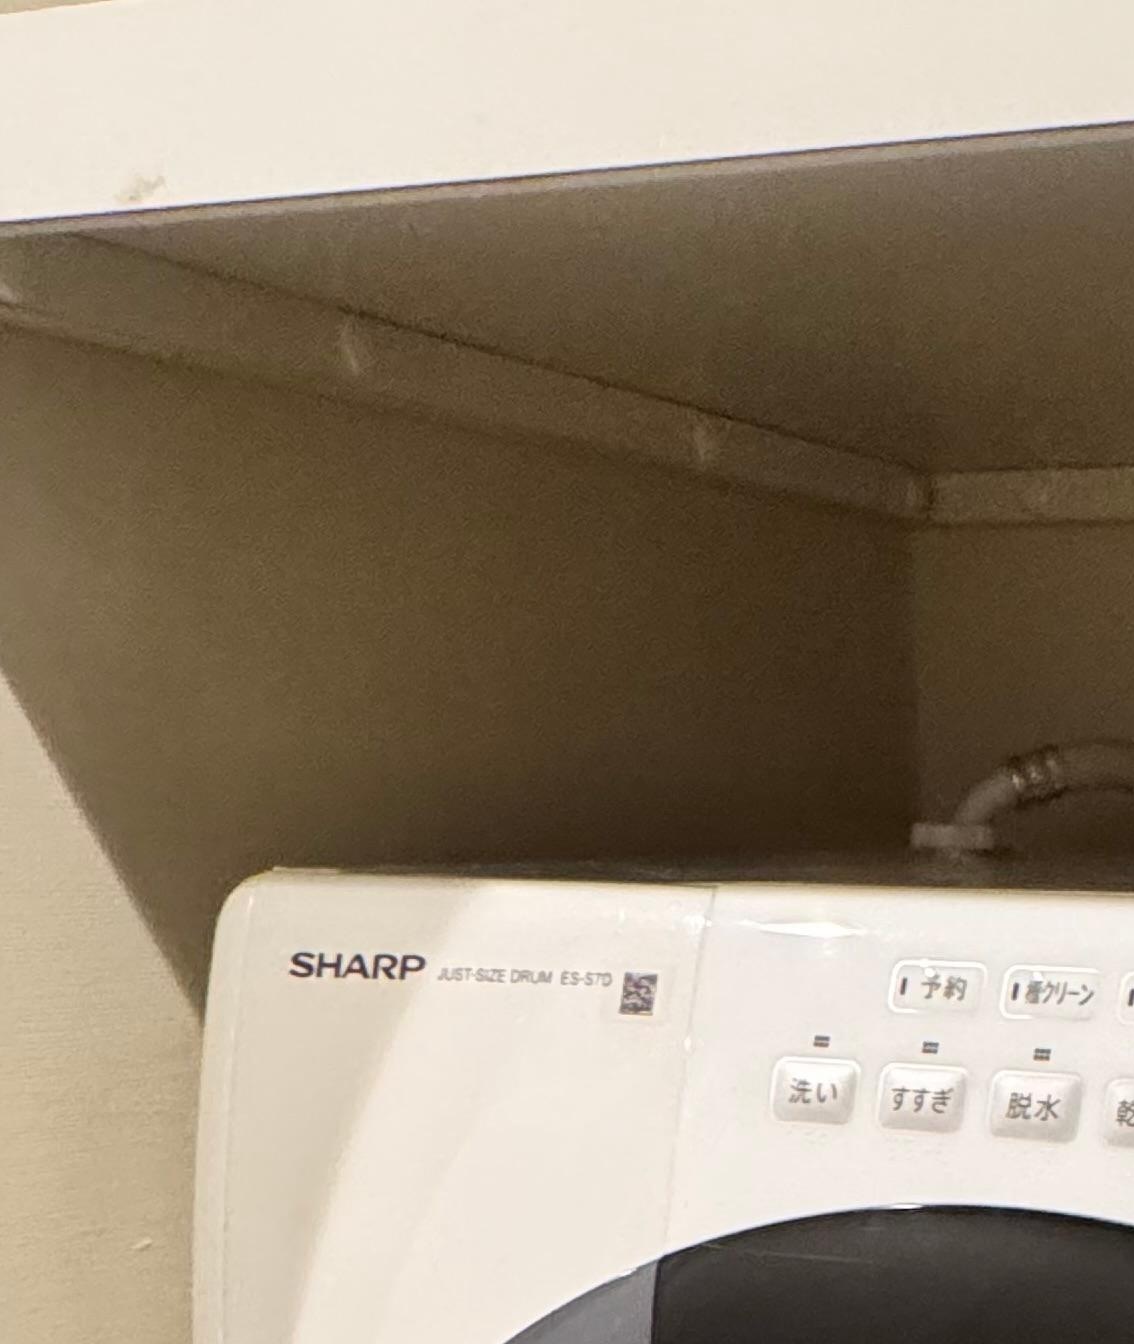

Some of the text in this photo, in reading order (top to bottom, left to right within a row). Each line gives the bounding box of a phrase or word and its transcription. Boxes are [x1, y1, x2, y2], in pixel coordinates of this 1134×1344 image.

[289, 952, 426, 980] SHARP
[437, 967, 506, 983] JUST-SIZE
[510, 969, 553, 984] DRUM
[921, 973, 967, 1001] 予約
[788, 1077, 837, 1104] 洗い
[891, 1087, 953, 1114] すすぎ
[1006, 1092, 1060, 1121] 脱水
